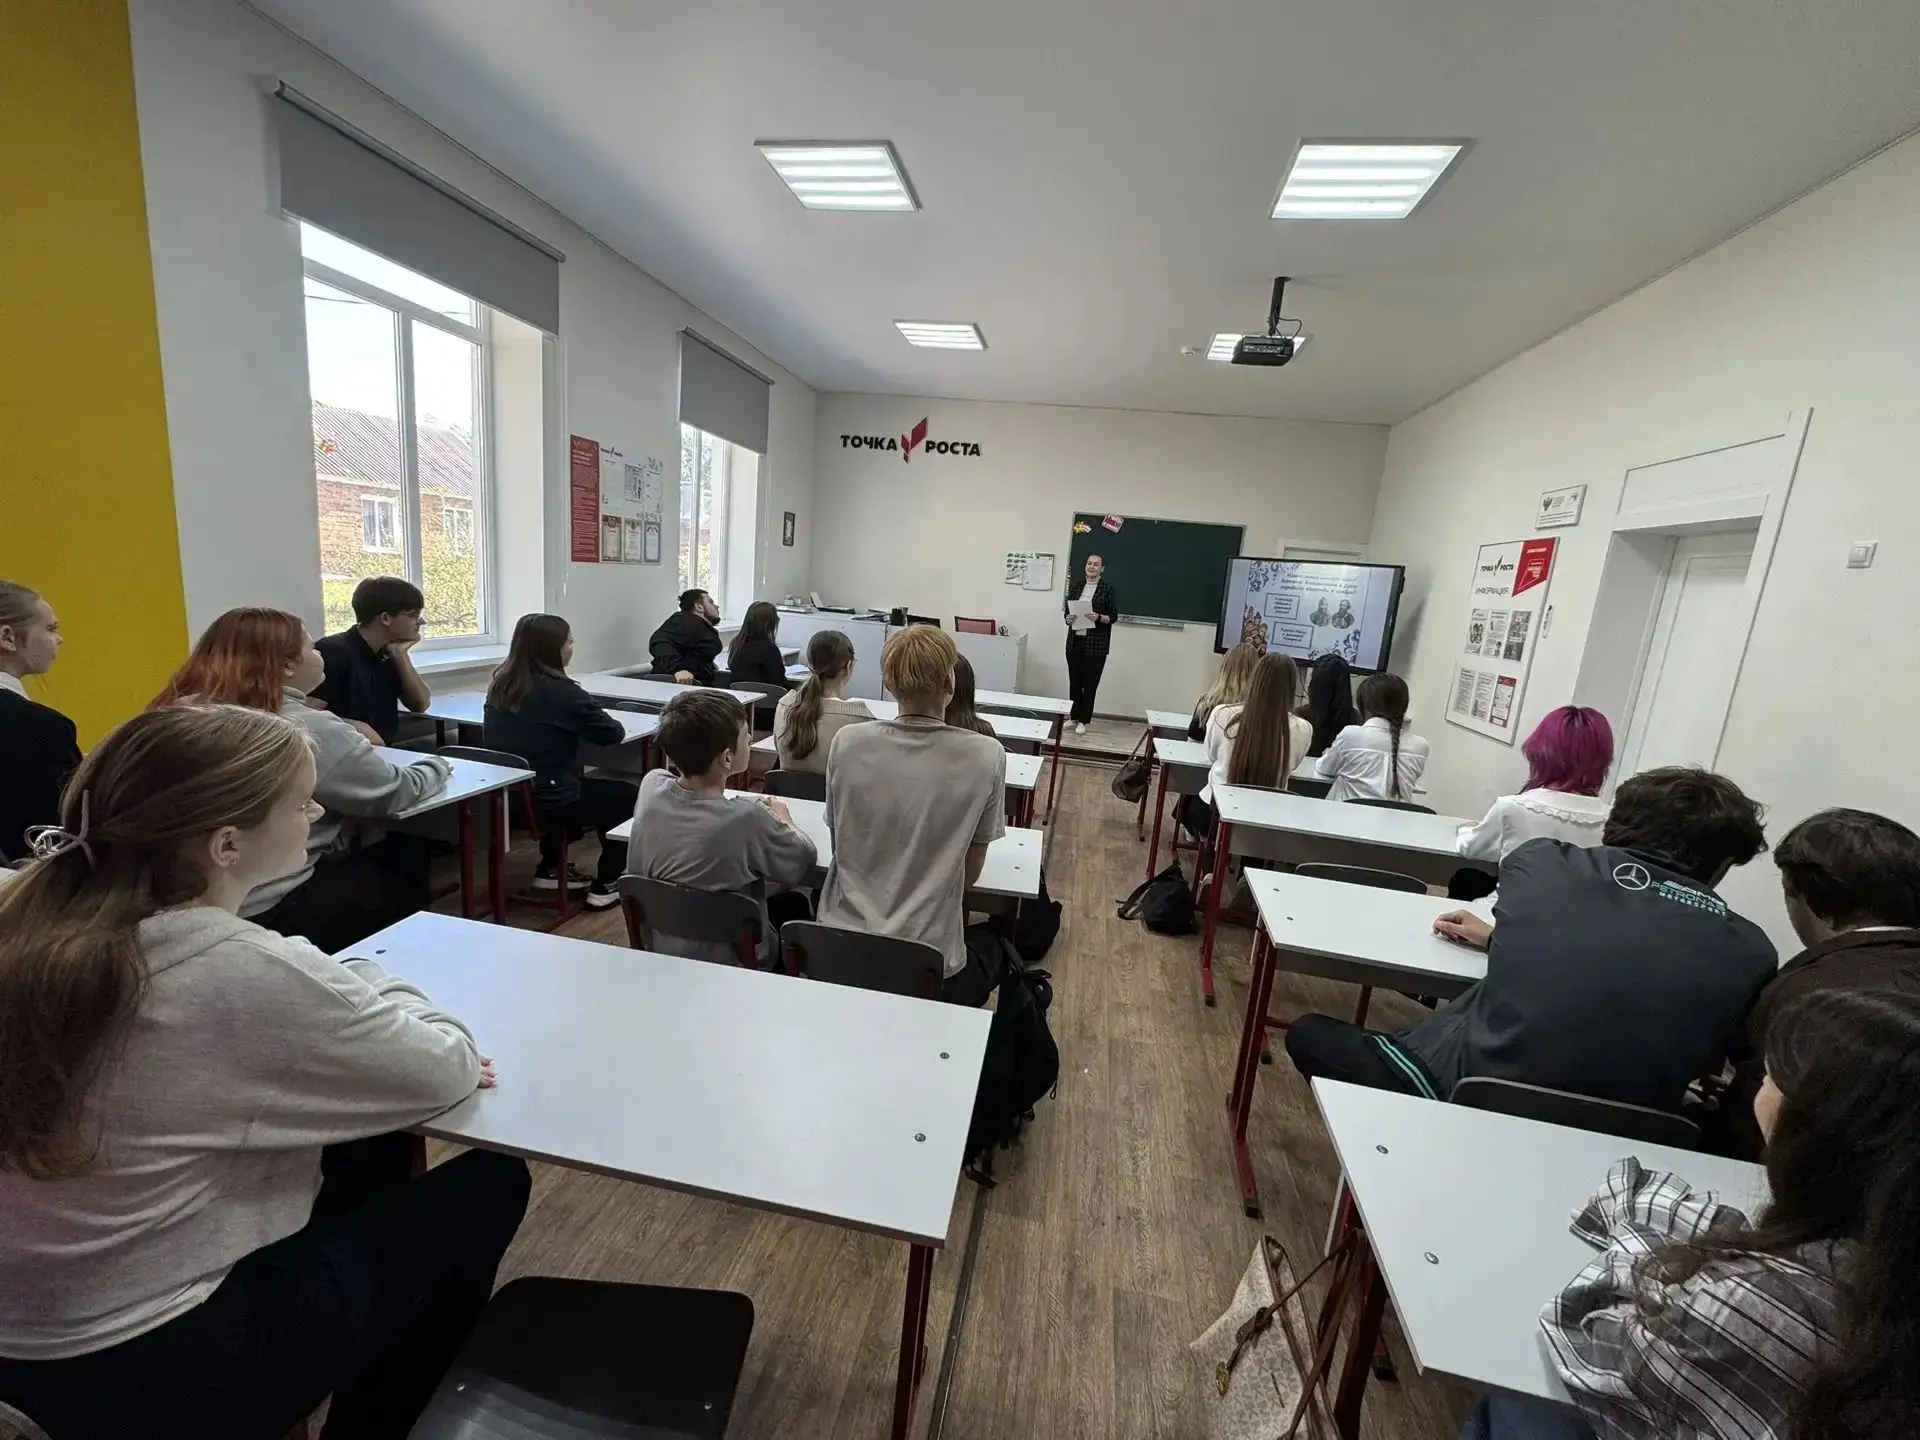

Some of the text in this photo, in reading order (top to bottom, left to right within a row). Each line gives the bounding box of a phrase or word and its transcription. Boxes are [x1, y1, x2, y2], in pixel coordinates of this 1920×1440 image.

[840, 434, 981, 457] ТОЧКА РОСТА
[1499, 563, 1514, 571] РОСТА
[1651, 881, 1725, 911] PETRONAS
[1659, 891, 1726, 916] MOTORSPORT
